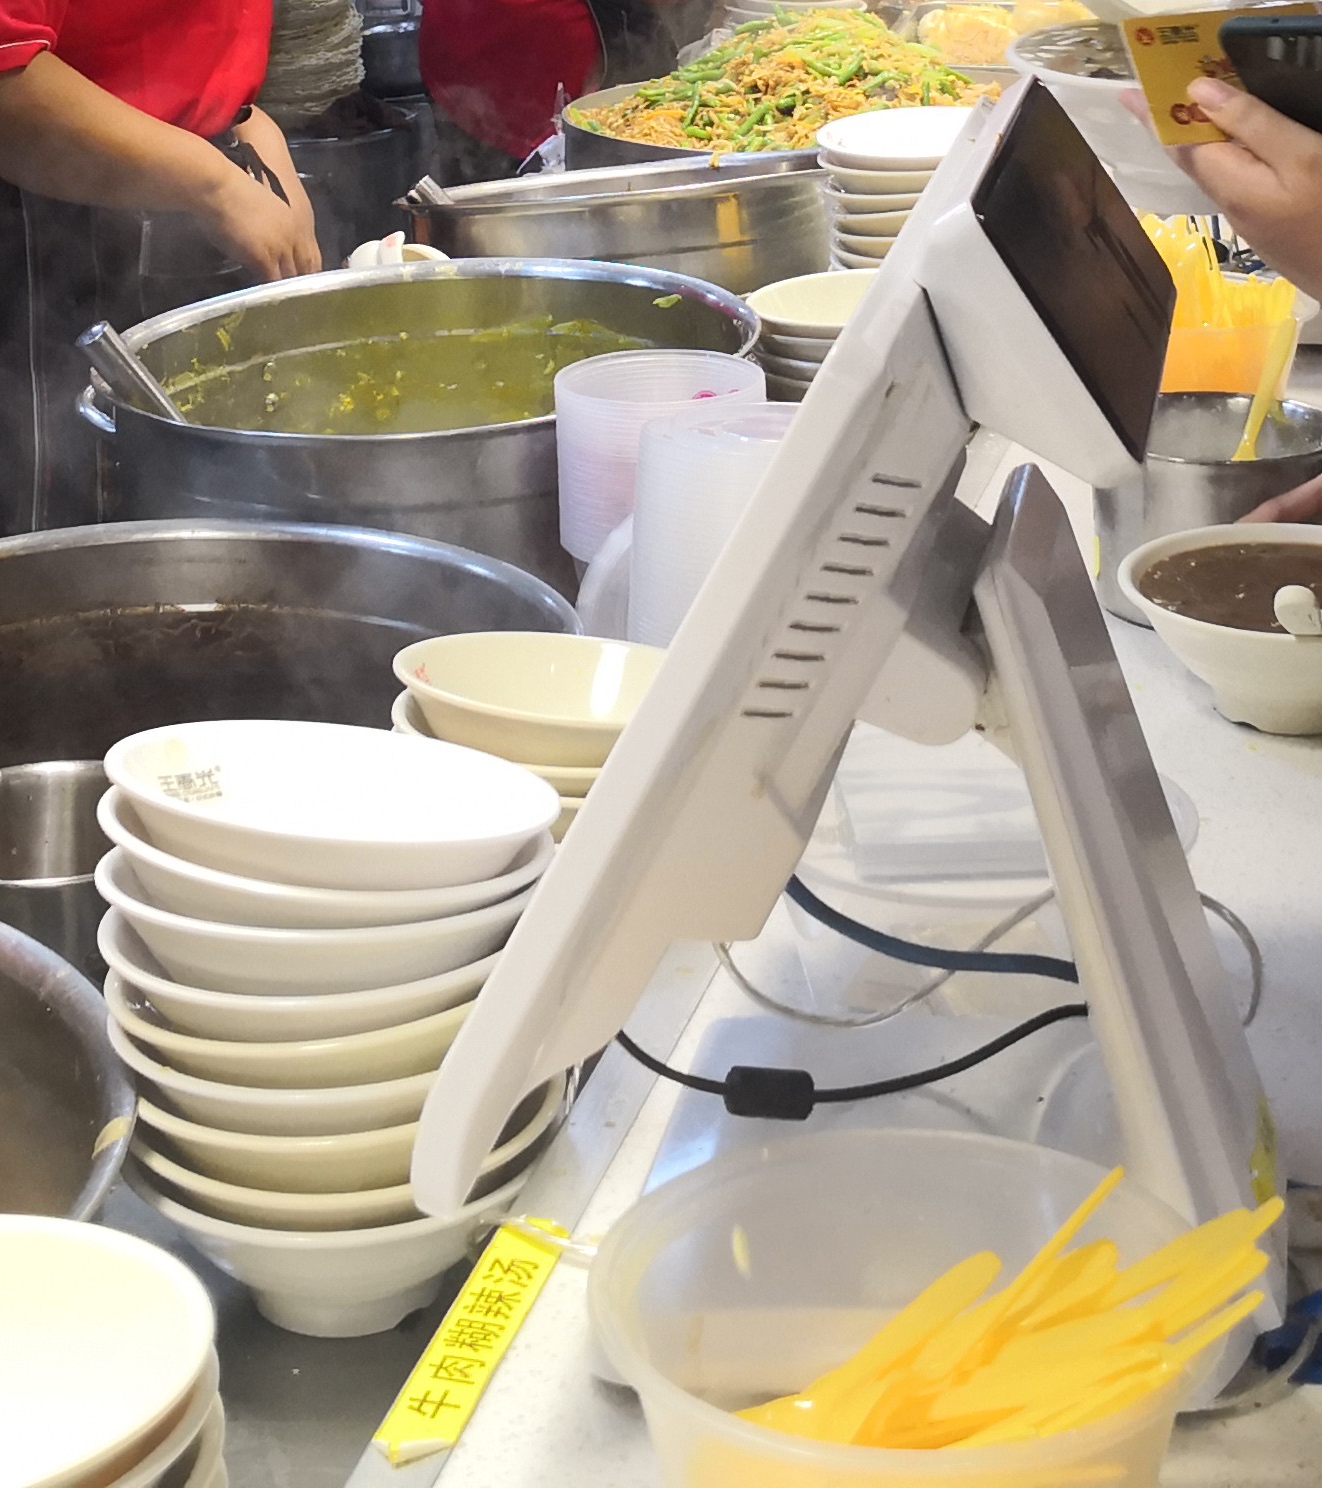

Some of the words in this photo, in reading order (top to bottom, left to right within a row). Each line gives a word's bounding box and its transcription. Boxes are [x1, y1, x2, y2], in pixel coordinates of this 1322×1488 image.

[406, 1257, 540, 1420] 牛肉糊辣汤
